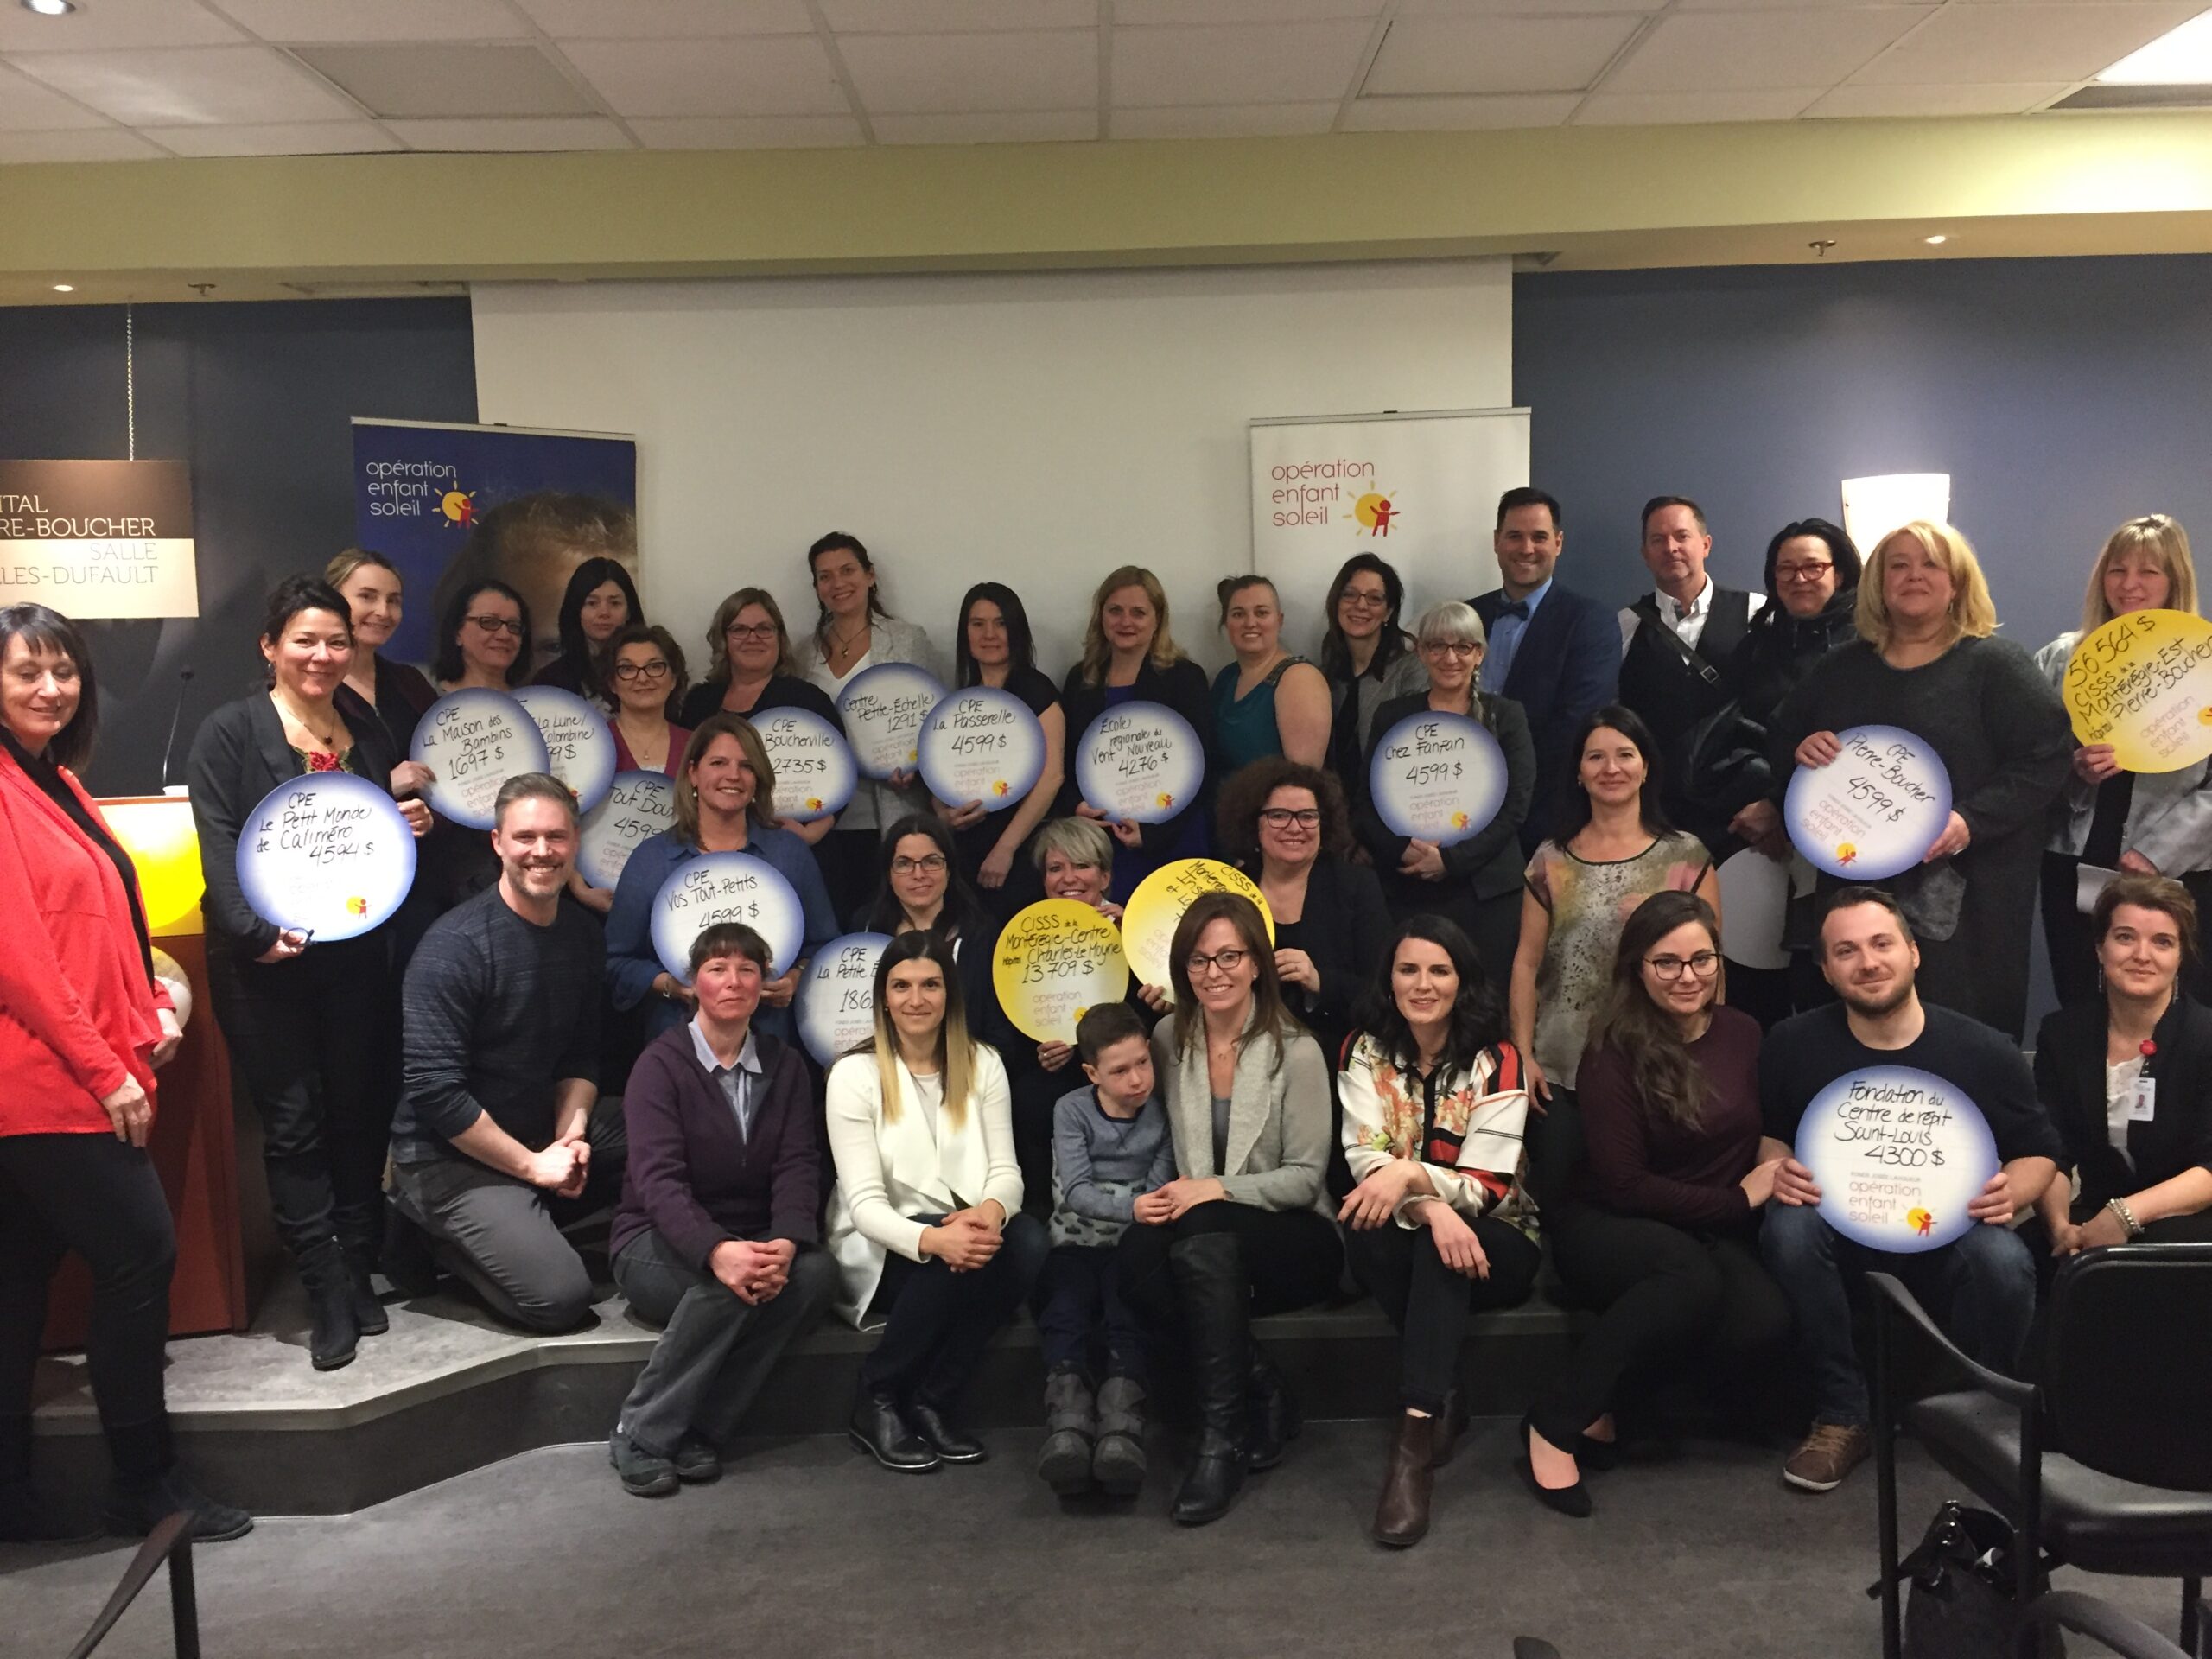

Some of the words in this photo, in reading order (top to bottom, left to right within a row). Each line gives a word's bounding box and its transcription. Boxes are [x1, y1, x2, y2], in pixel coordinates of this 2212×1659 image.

[365, 459, 456, 480] opération
[1272, 459, 1375, 484] opération
[367, 480, 429, 498] enfant
[1272, 483, 1340, 504] enfant
[370, 499, 421, 516] soleil
[1273, 506, 1328, 526] soleil
[90, 543, 158, 561] SALLE
[0, 566, 159, 585] LES-DUFAULT
[2069, 652, 2100, 688] 56
[2095, 623, 2139, 664] 564
[2136, 615, 2156, 632] $
[2075, 671, 2116, 708] CISSS
[435, 707, 460, 726] CPE
[958, 699, 984, 714] CPE
[772, 718, 798, 733] CPE
[887, 713, 917, 734] 1291
[933, 719, 948, 730] La
[953, 709, 1016, 729] Passerelle
[423, 735, 438, 747] La
[442, 720, 484, 742] Maison
[488, 715, 502, 728] des
[1415, 723, 1439, 741] CPE
[460, 728, 512, 757] Bambins
[765, 733, 836, 753] Boucherville
[951, 734, 995, 755] 4599
[998, 732, 1007, 749] $
[1090, 747, 1116, 766] Vent
[1127, 738, 1172, 757] Nouveau
[1385, 745, 1411, 760] Chez
[1416, 737, 1465, 757] Fanfan
[449, 749, 489, 780] 1697
[494, 746, 505, 760] $
[1886, 744, 1916, 764] CPE
[772, 758, 815, 774] 2735
[1118, 755, 1158, 778] 4276
[1161, 753, 1169, 764] $
[1406, 762, 1449, 785] 4599
[1452, 760, 1464, 779] $
[610, 785, 638, 806] Tout
[634, 779, 666, 798] CPE
[289, 792, 316, 809] CPE
[1847, 777, 1893, 815] 4599
[1885, 807, 1906, 822] $
[259, 819, 274, 832] Le
[283, 811, 318, 830] Petit
[323, 804, 372, 825] Monde
[257, 837, 271, 853] de
[309, 842, 359, 867] 4594
[364, 841, 374, 855] $
[684, 869, 710, 888] CPE
[665, 890, 689, 912] Vos
[690, 874, 758, 904] Tout-Petits
[699, 906, 742, 928] 4599
[748, 899, 760, 919] $
[1020, 914, 1060, 932] CISSS
[840, 947, 868, 963] CPE
[817, 965, 830, 979] La
[836, 963, 868, 979] Petite
[1081, 959, 1095, 976] $
[839, 988, 874, 1013] 186
[1849, 1080, 1923, 1104] Fondation
[1928, 1092, 1944, 1106] du
[1837, 1102, 1892, 1122] Centre
[1898, 1108, 1914, 1122] de
[1834, 1121, 1933, 1146] Saint-Louis
[1864, 1145, 1928, 1166] 4300
[1931, 1147, 1945, 1166] $
[1849, 1196, 1896, 1210] enfant
[1849, 1211, 1888, 1224] soleil
